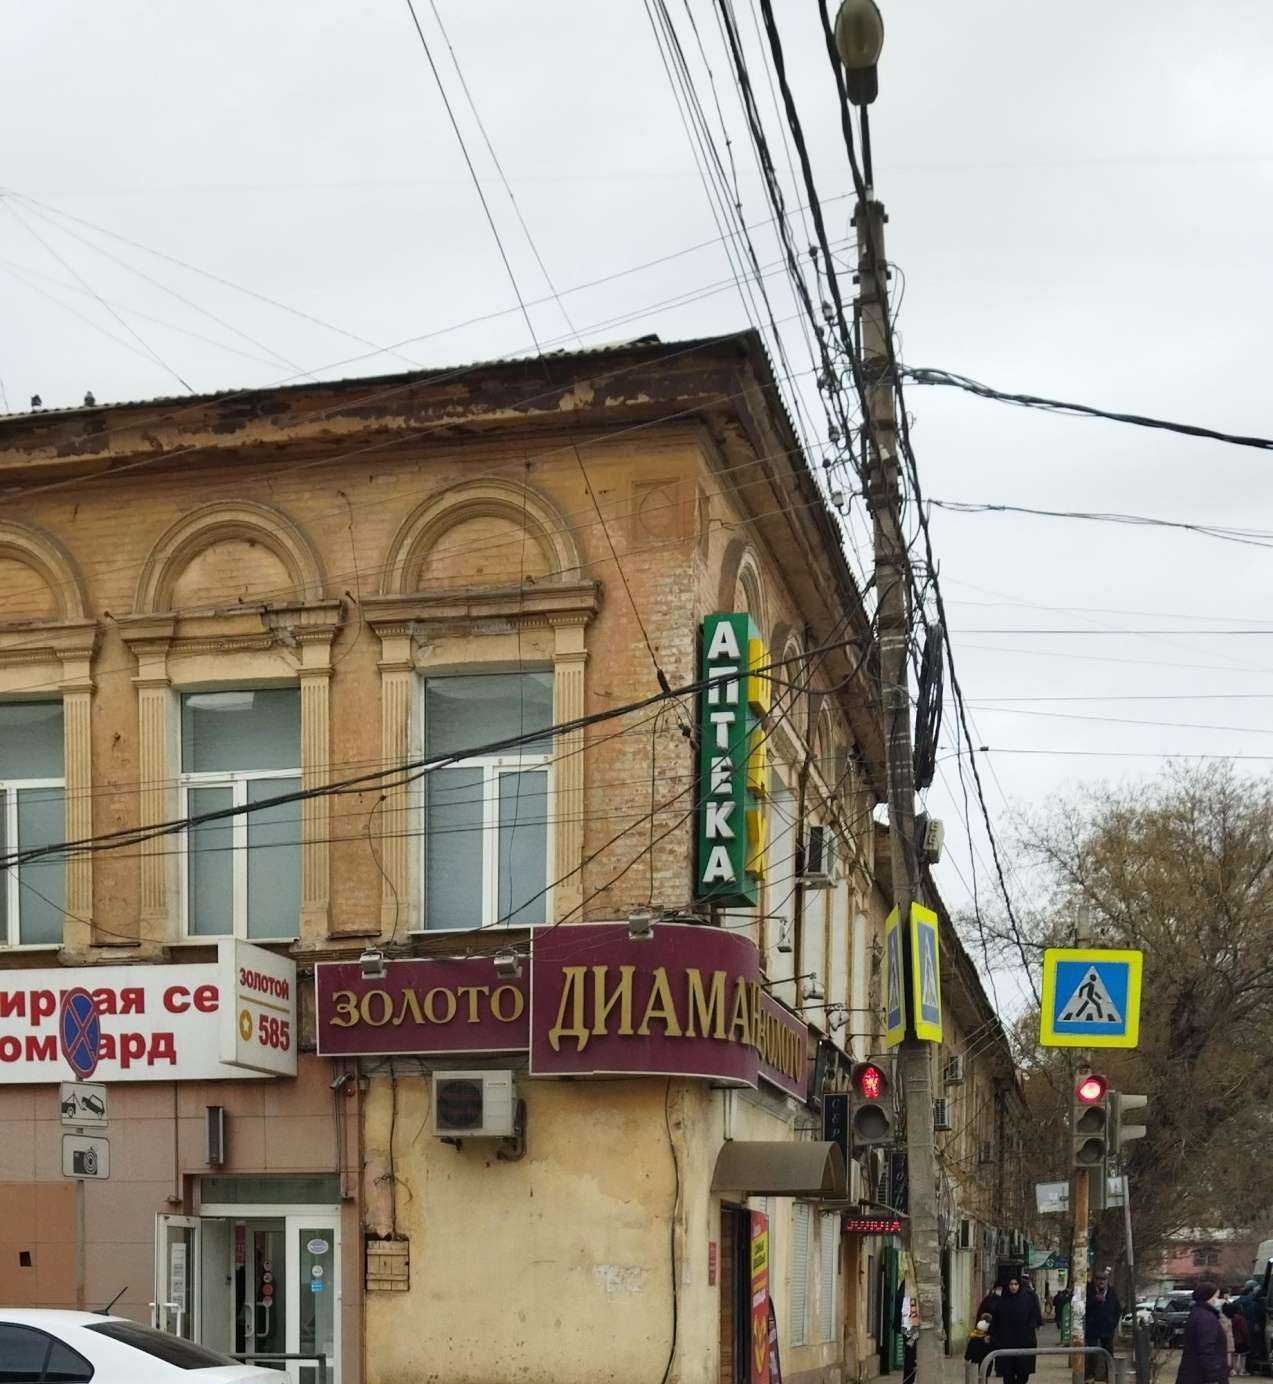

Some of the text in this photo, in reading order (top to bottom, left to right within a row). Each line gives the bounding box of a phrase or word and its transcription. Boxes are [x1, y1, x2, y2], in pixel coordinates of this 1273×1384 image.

[702, 621, 741, 883] АПТЕКА
[239, 966, 289, 1000] ЗОЛОТОЙ
[0, 984, 220, 1026] ирая се
[330, 985, 524, 1027] ЗОЛОТО
[0, 1032, 177, 1069] омард
[258, 1013, 290, 1051] 585
